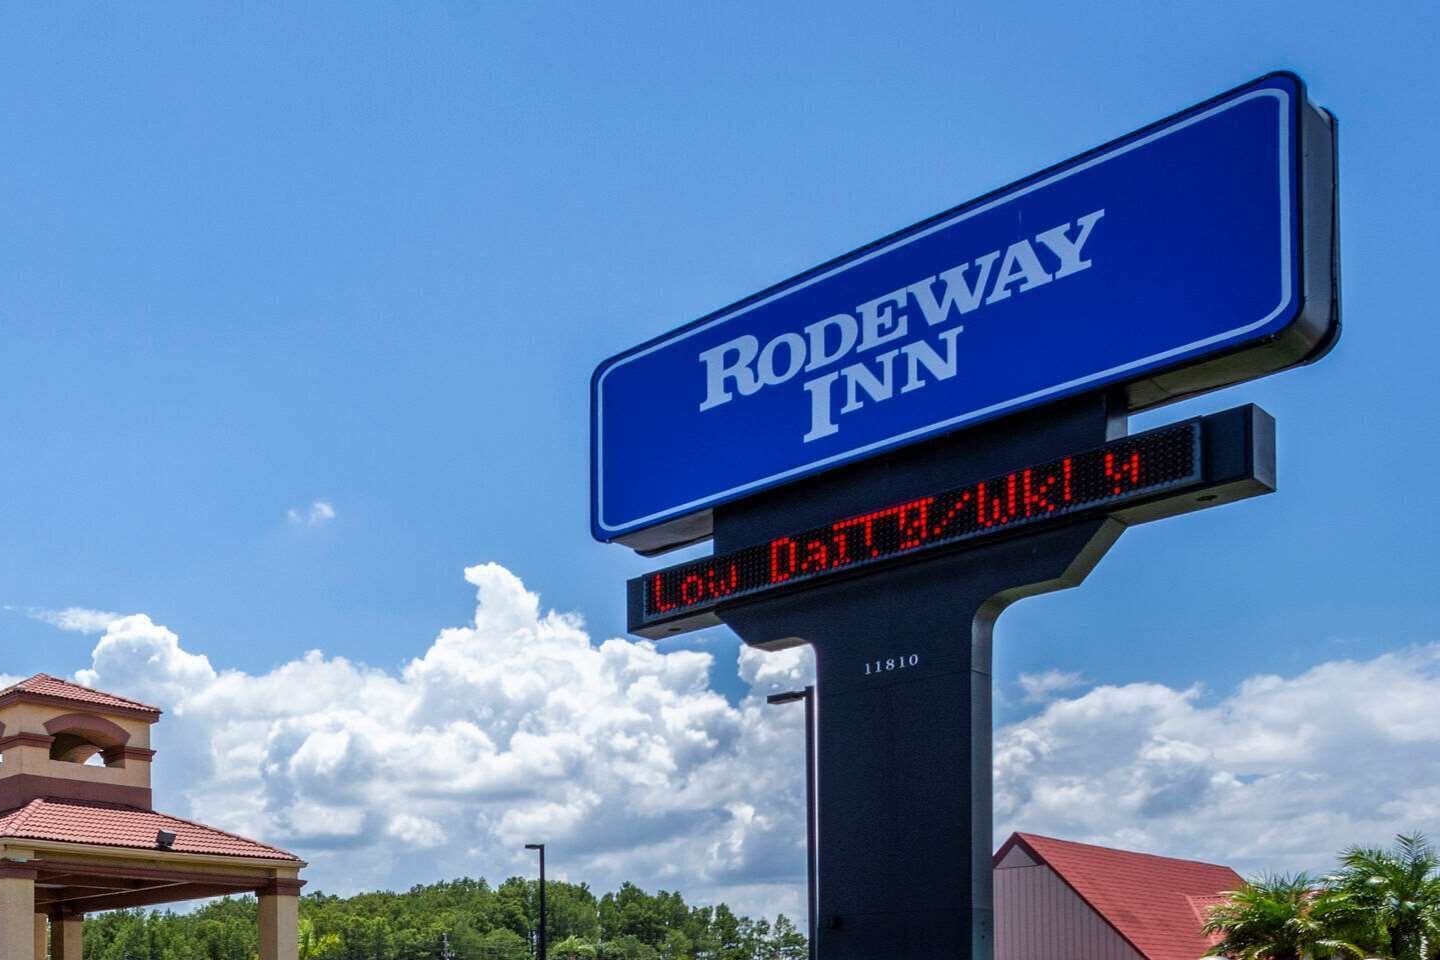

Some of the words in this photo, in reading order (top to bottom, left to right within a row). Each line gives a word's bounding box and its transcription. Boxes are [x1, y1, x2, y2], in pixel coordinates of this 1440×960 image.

[698, 208, 1105, 412] RODEWAY
[802, 326, 964, 443] INN
[653, 562, 737, 613] Low
[865, 653, 919, 675] 11810
